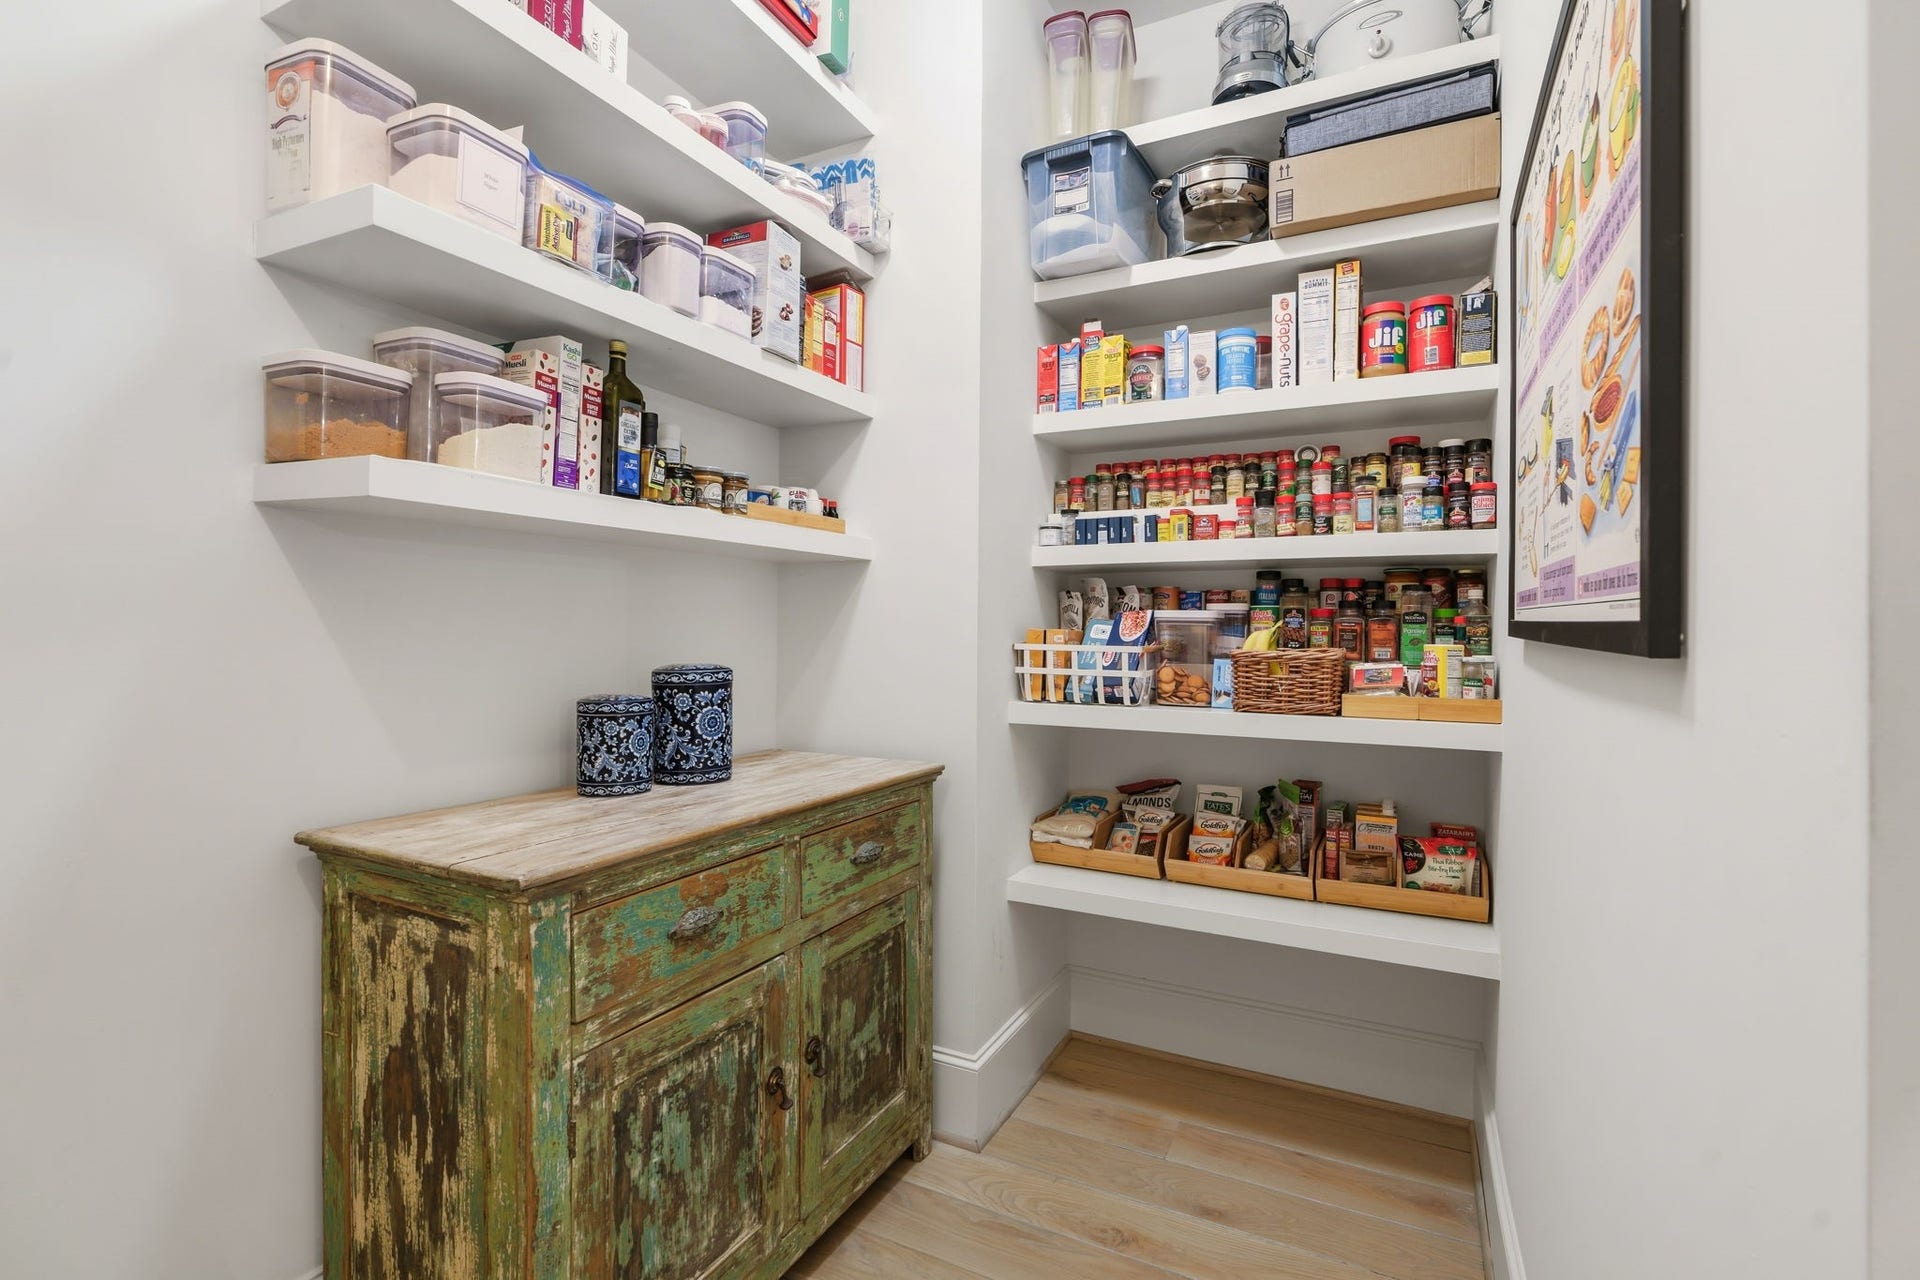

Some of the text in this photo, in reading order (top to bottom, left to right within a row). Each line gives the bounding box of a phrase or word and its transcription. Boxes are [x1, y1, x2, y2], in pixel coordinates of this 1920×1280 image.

[1304, 282, 1329, 290] SUMMIT
[1416, 308, 1445, 329] Jif
[1368, 326, 1404, 348] Jif
[1275, 313, 1293, 388] grape-nuts
[505, 358, 527, 369] Muesli
[536, 379, 556, 391] Muesli
[1403, 628, 1425, 636] Parsley
[1126, 797, 1172, 809] LMONDS
[1200, 820, 1229, 831] Goldfish
[1195, 846, 1224, 855] Goldfish
